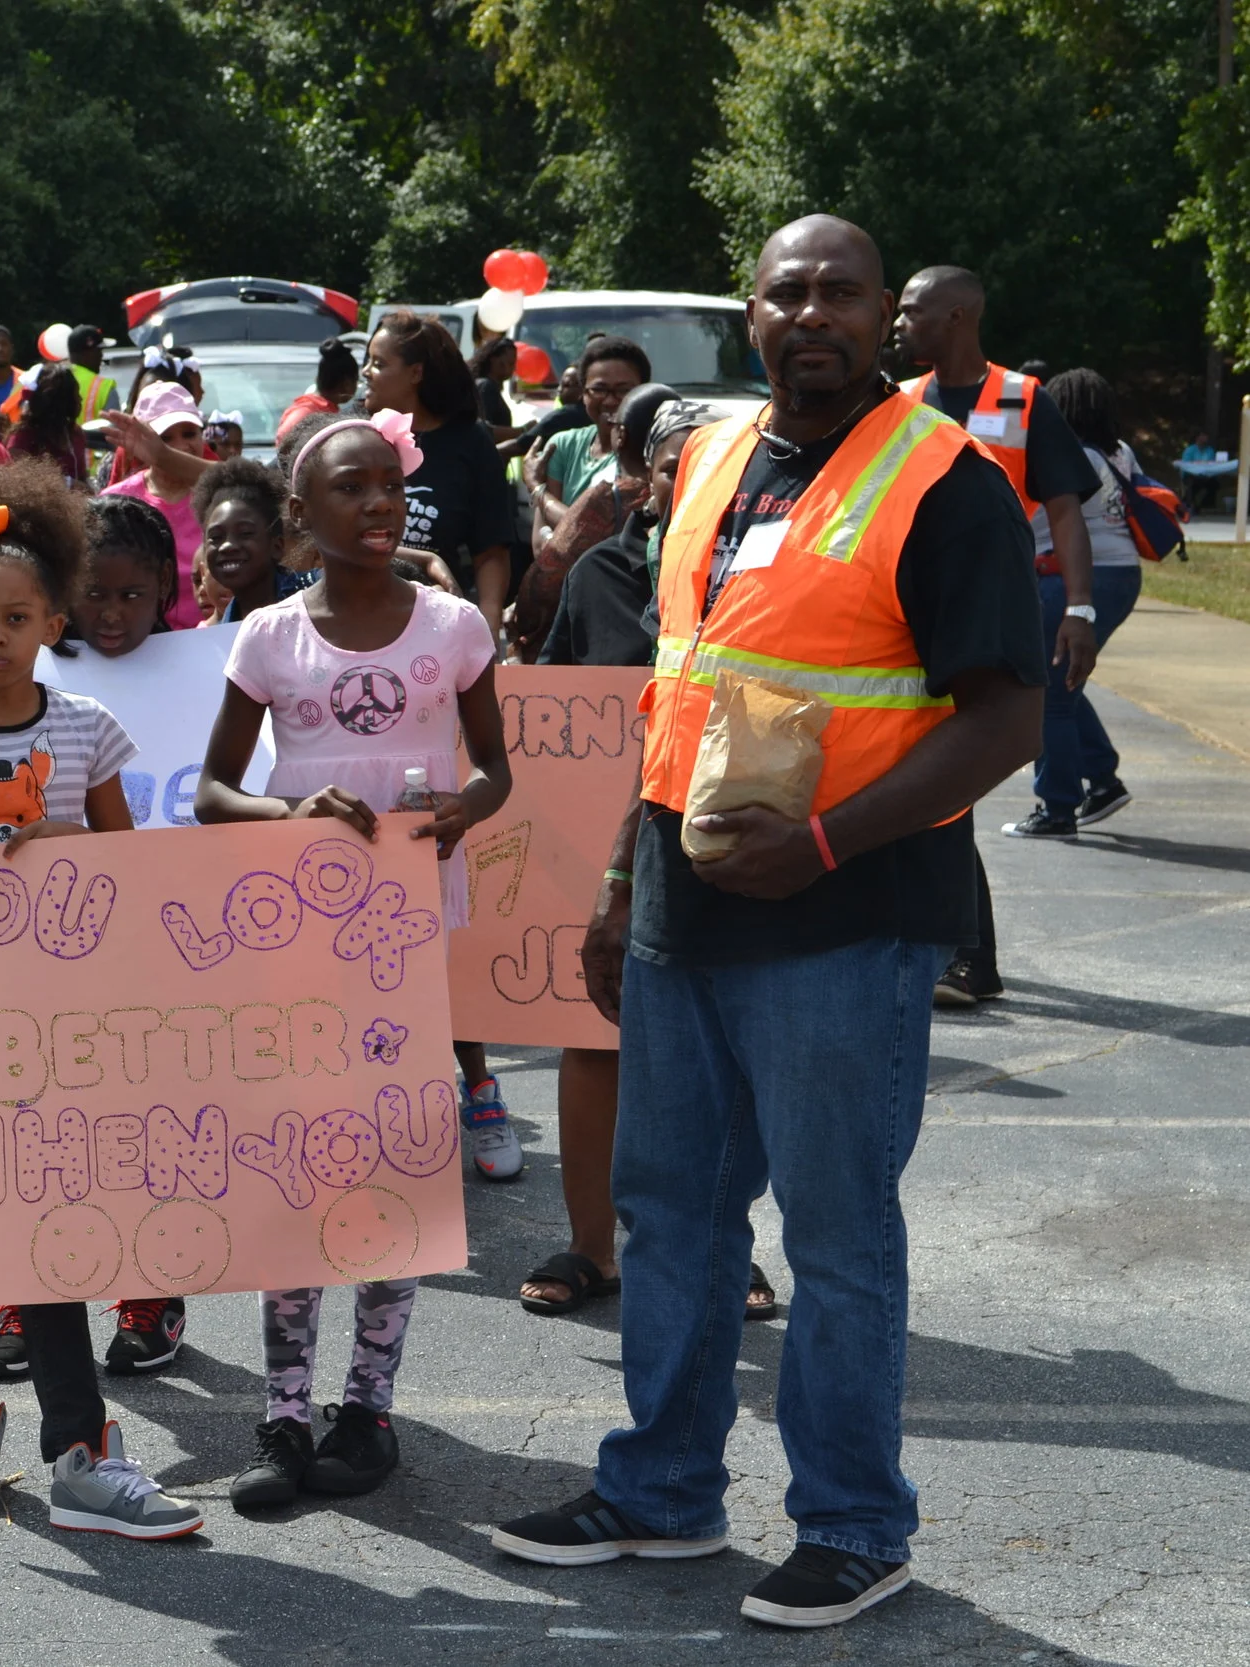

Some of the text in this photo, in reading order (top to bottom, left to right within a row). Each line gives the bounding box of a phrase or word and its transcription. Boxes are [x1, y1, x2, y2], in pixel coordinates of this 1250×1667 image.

[405, 496, 439, 519] he
[160, 838, 440, 991] LOOK
[232, 1079, 459, 1210] YOU
